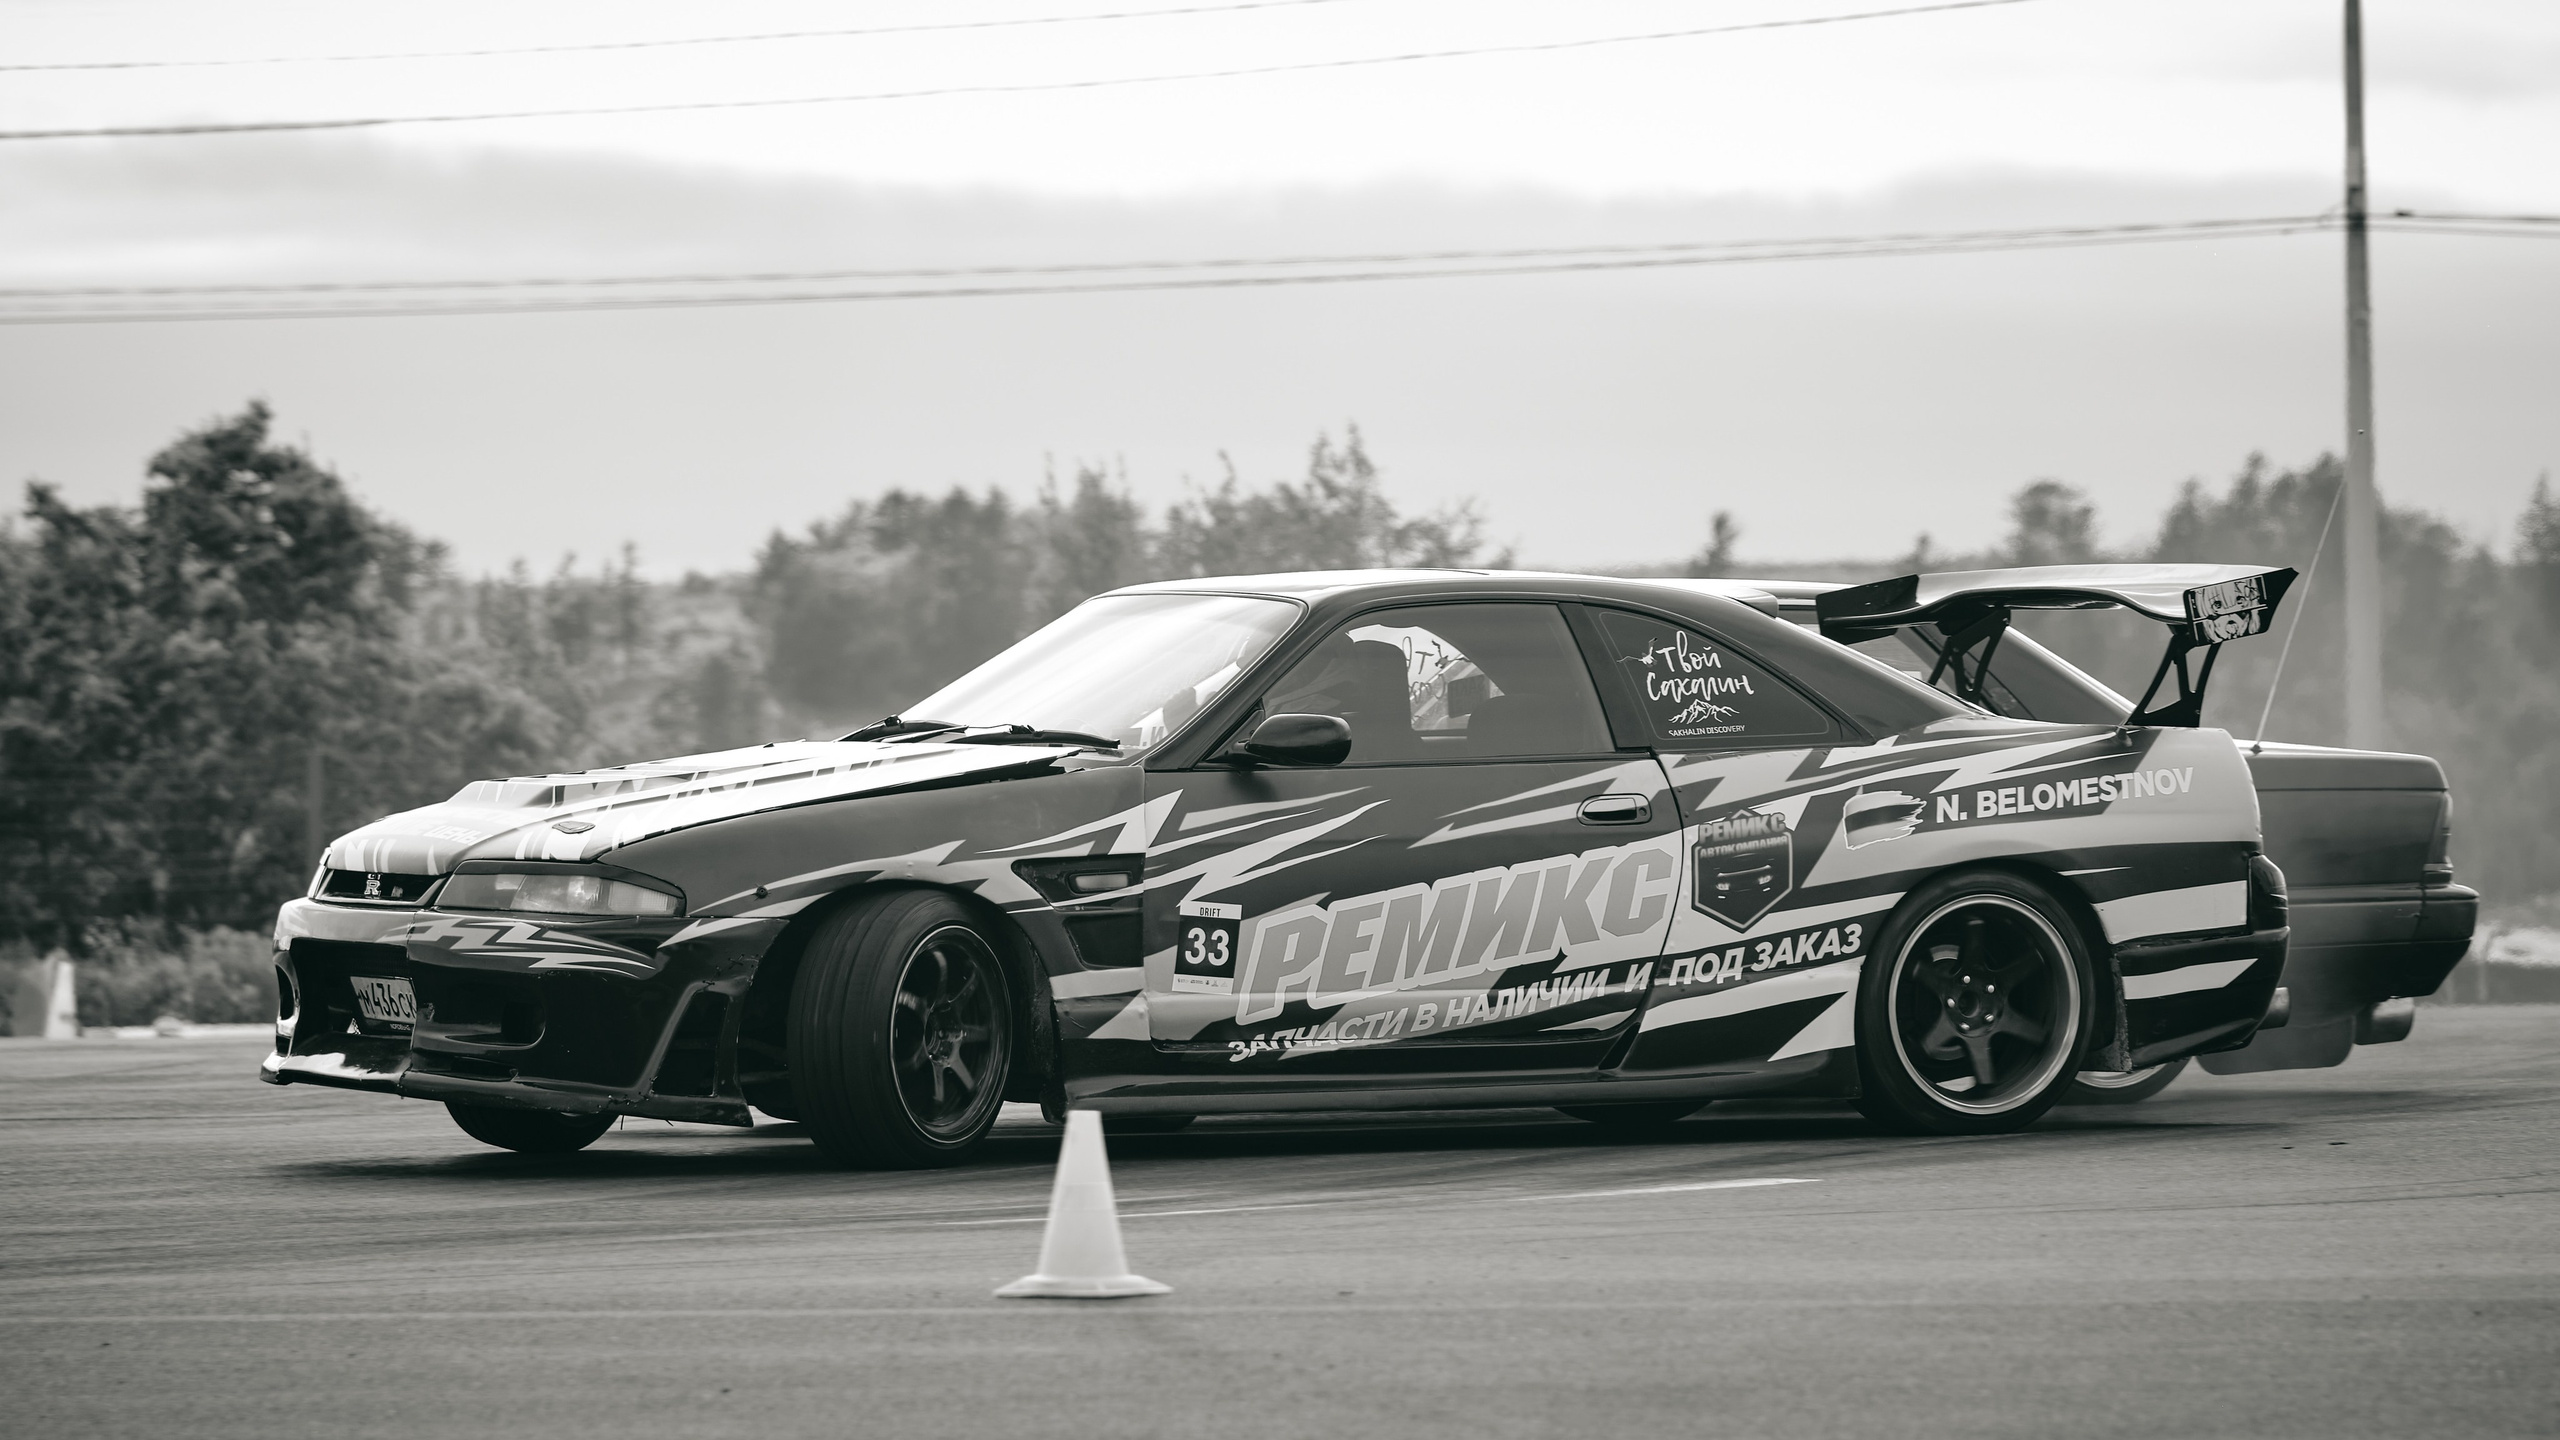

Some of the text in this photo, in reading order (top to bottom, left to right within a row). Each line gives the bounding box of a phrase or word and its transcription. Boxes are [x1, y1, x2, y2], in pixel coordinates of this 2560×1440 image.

[1655, 630, 1722, 673] Твой
[1646, 672, 1755, 703] Сахалин
[1668, 724, 1746, 736] SAKHALIN DISCOVERY
[1936, 766, 2194, 824] N. BELOMESTNOV
[1699, 812, 1786, 844] РЕМИКС
[1700, 835, 1789, 859] АВТОКОМПАНИЯ
[1199, 907, 1221, 917] DRIFT
[1185, 927, 1230, 966] 33
[1241, 846, 1676, 1020] РЕМИКС
[1227, 923, 1863, 1062] ЗАПЧАСТИ В НАЛИЧИИ И ПОД ЗАКАЗ
